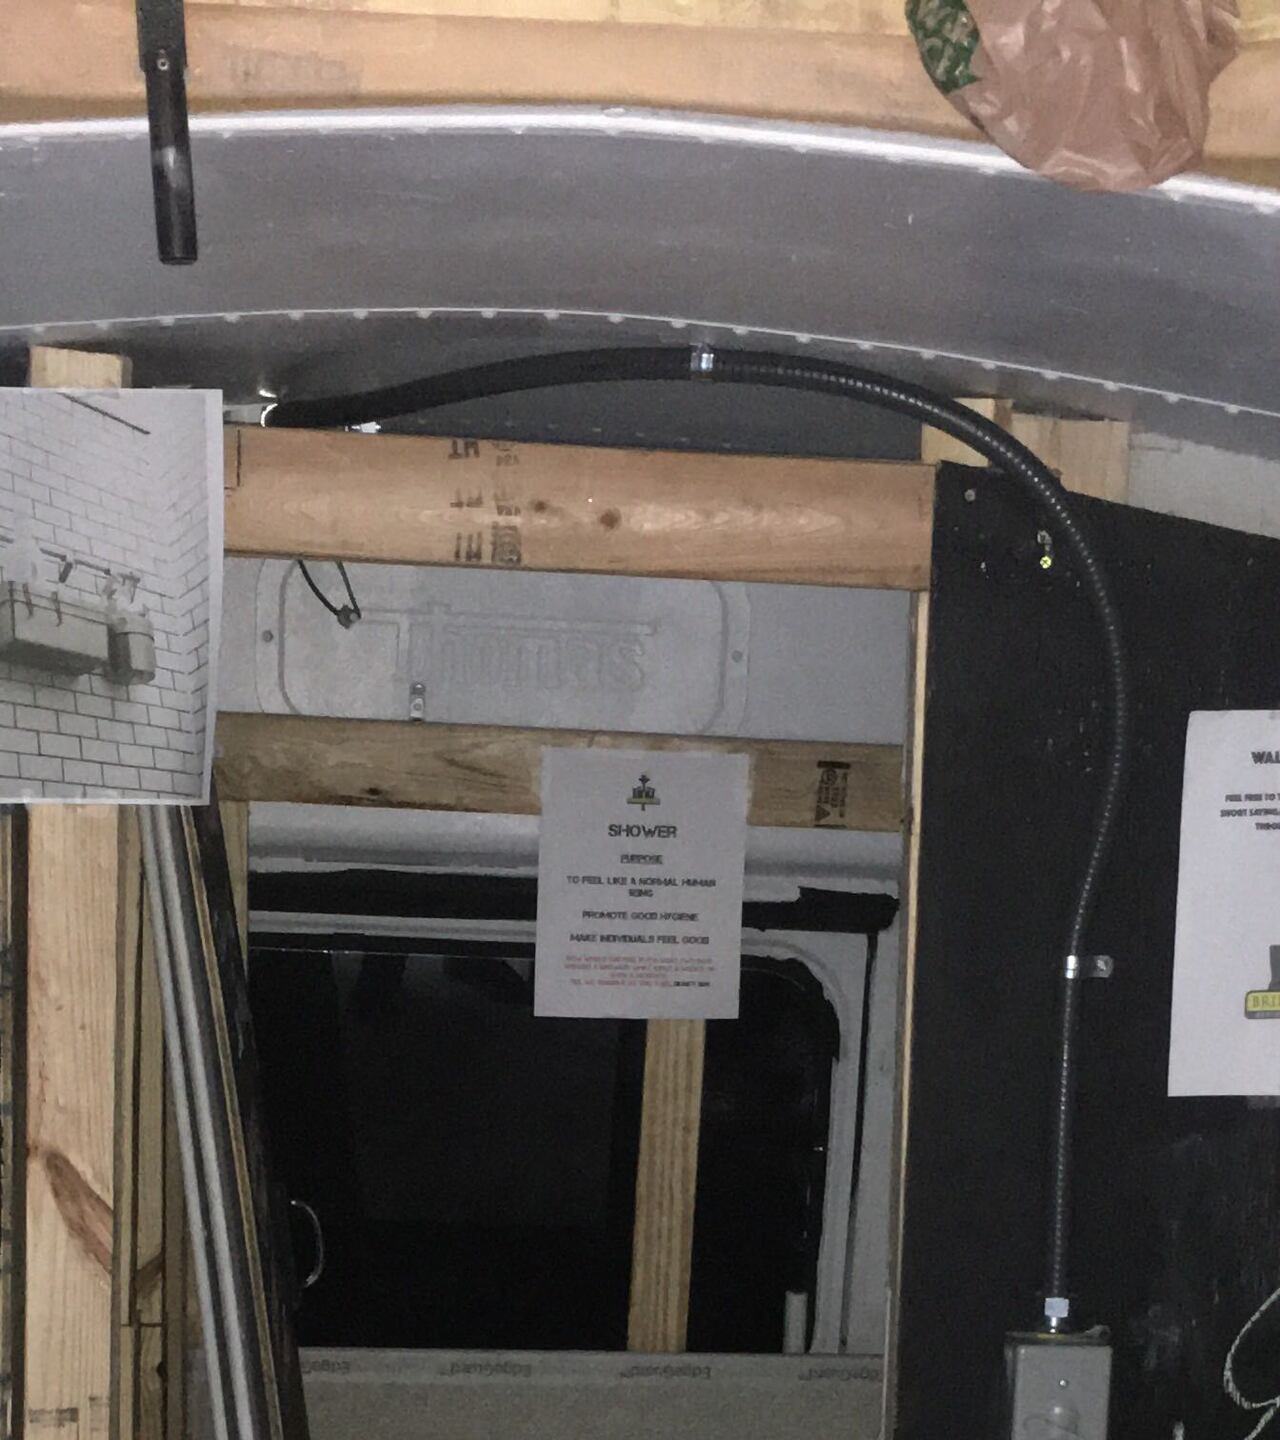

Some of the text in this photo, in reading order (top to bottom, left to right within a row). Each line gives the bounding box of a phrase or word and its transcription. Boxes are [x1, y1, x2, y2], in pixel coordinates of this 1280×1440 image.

[1265, 793, 1276, 801] TO
[608, 824, 677, 838] SHOWER
[567, 875, 580, 884] TO
[607, 876, 627, 886] LIKE
[582, 910, 628, 920] PROMOTE
[631, 911, 658, 920] GOOD
[570, 933, 596, 943] MAKE
[682, 935, 709, 945] GOOD
